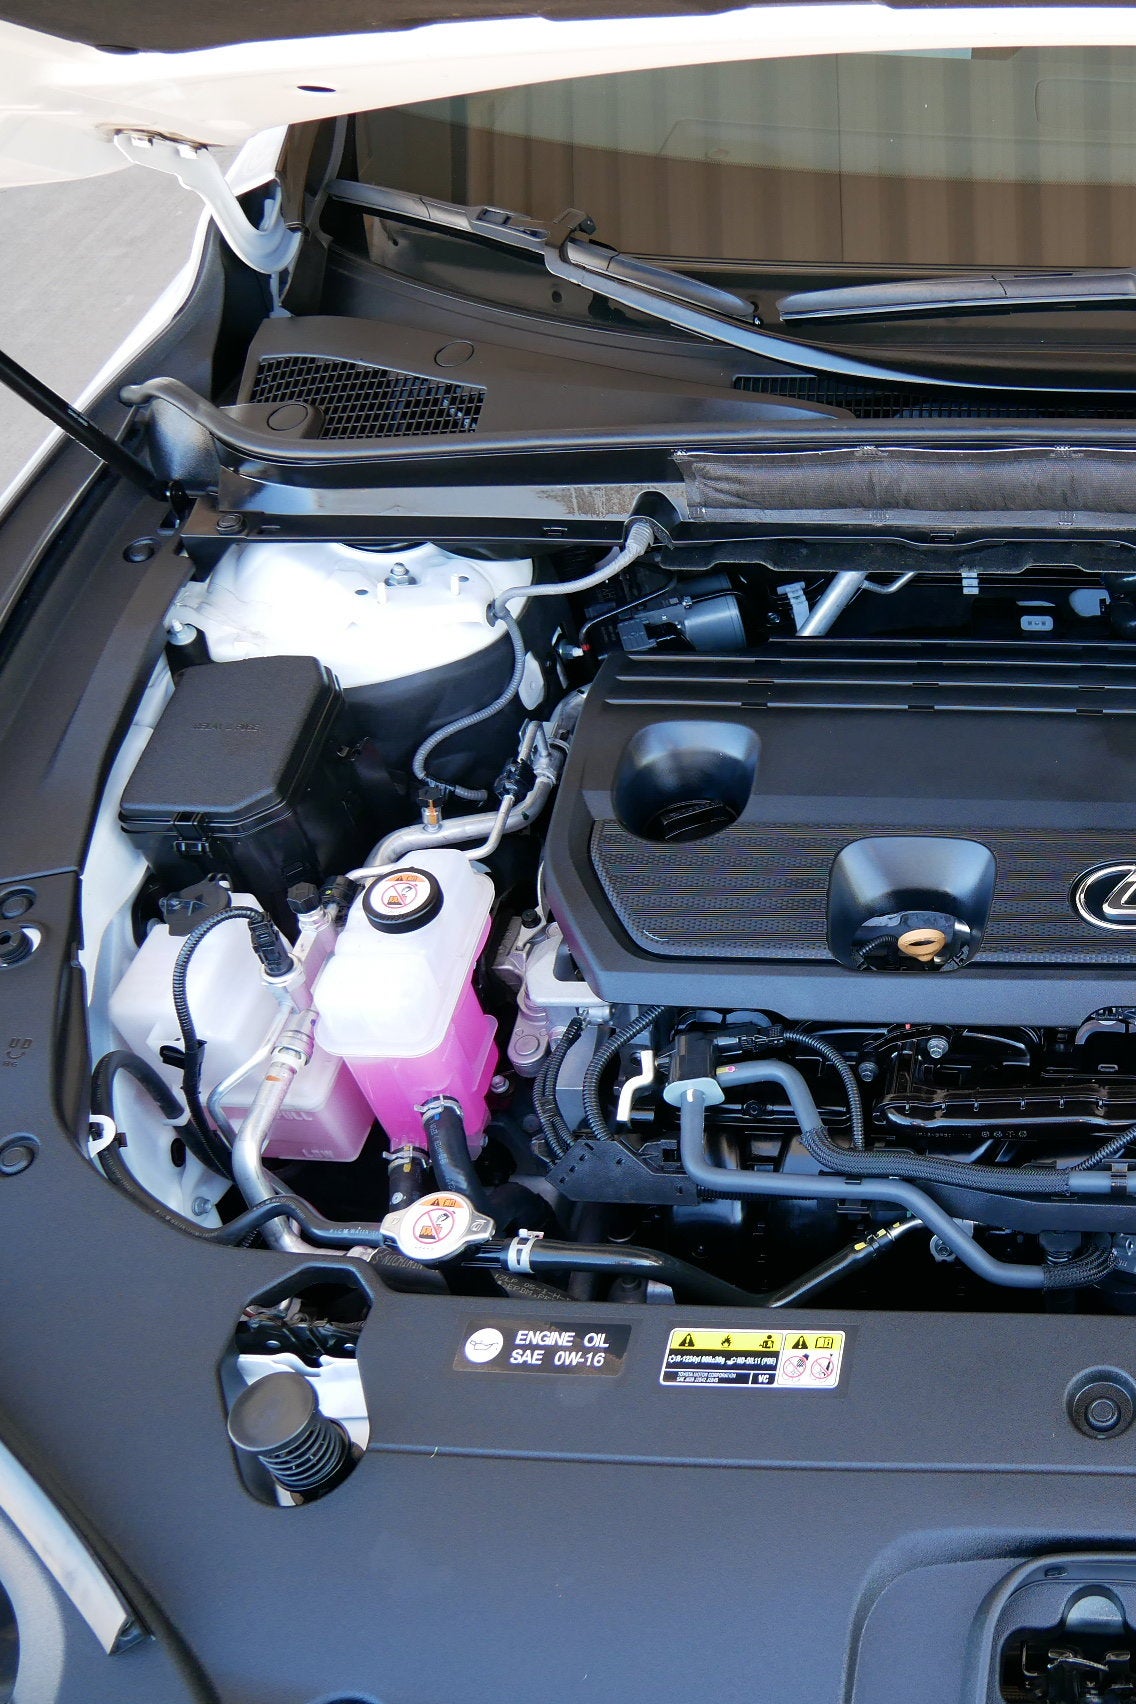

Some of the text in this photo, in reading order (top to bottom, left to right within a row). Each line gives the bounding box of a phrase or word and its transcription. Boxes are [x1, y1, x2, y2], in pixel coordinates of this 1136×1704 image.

[514, 1330, 610, 1348] ENGINE OIL
[509, 1348, 606, 1367] SAE 0W-16
[758, 1374, 770, 1383] VC
